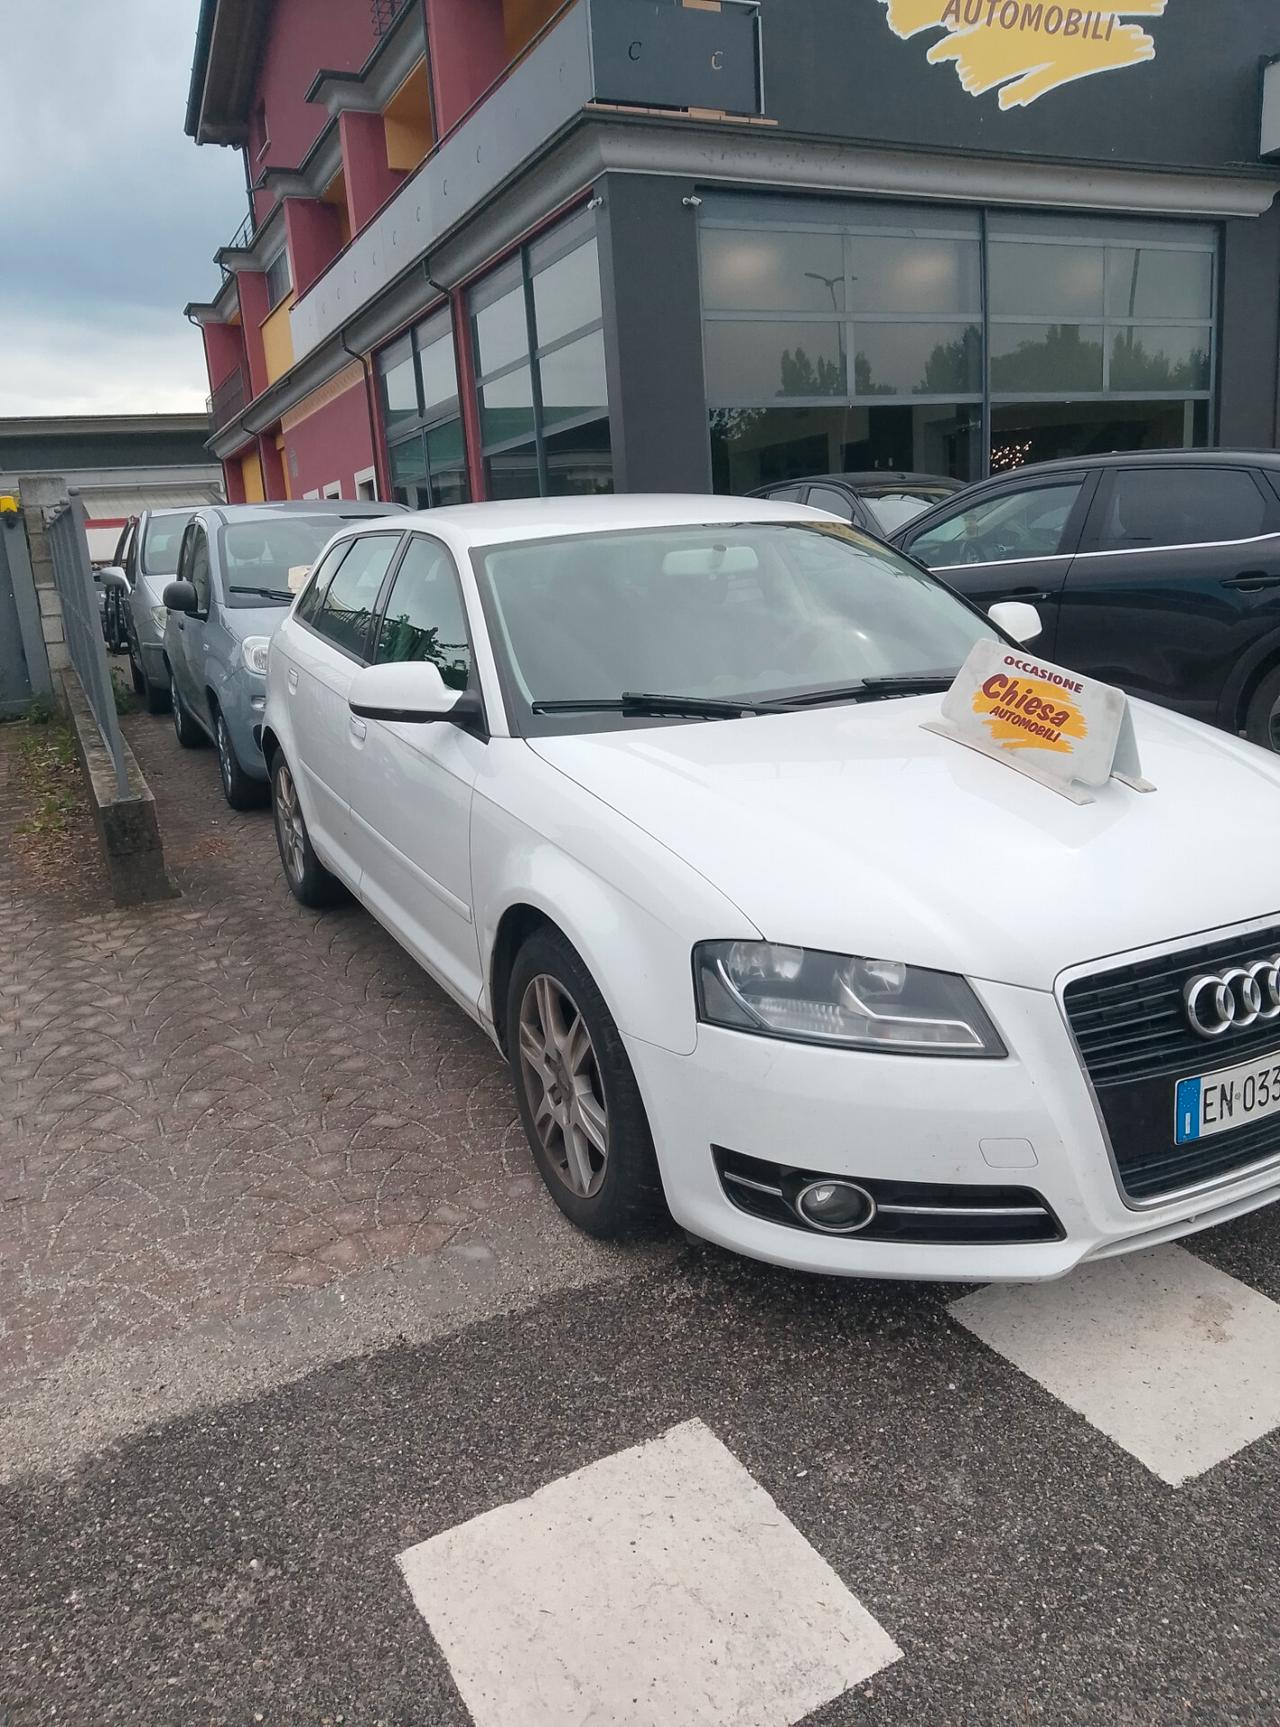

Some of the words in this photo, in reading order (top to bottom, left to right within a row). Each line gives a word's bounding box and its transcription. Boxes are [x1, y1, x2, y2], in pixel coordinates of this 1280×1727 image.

[940, 0, 1115, 42] AUTOMOBILI
[1004, 656, 1084, 693] OCCASIONE
[981, 673, 1071, 728] Chiesa
[989, 705, 1062, 742] AUTOMOBILI
